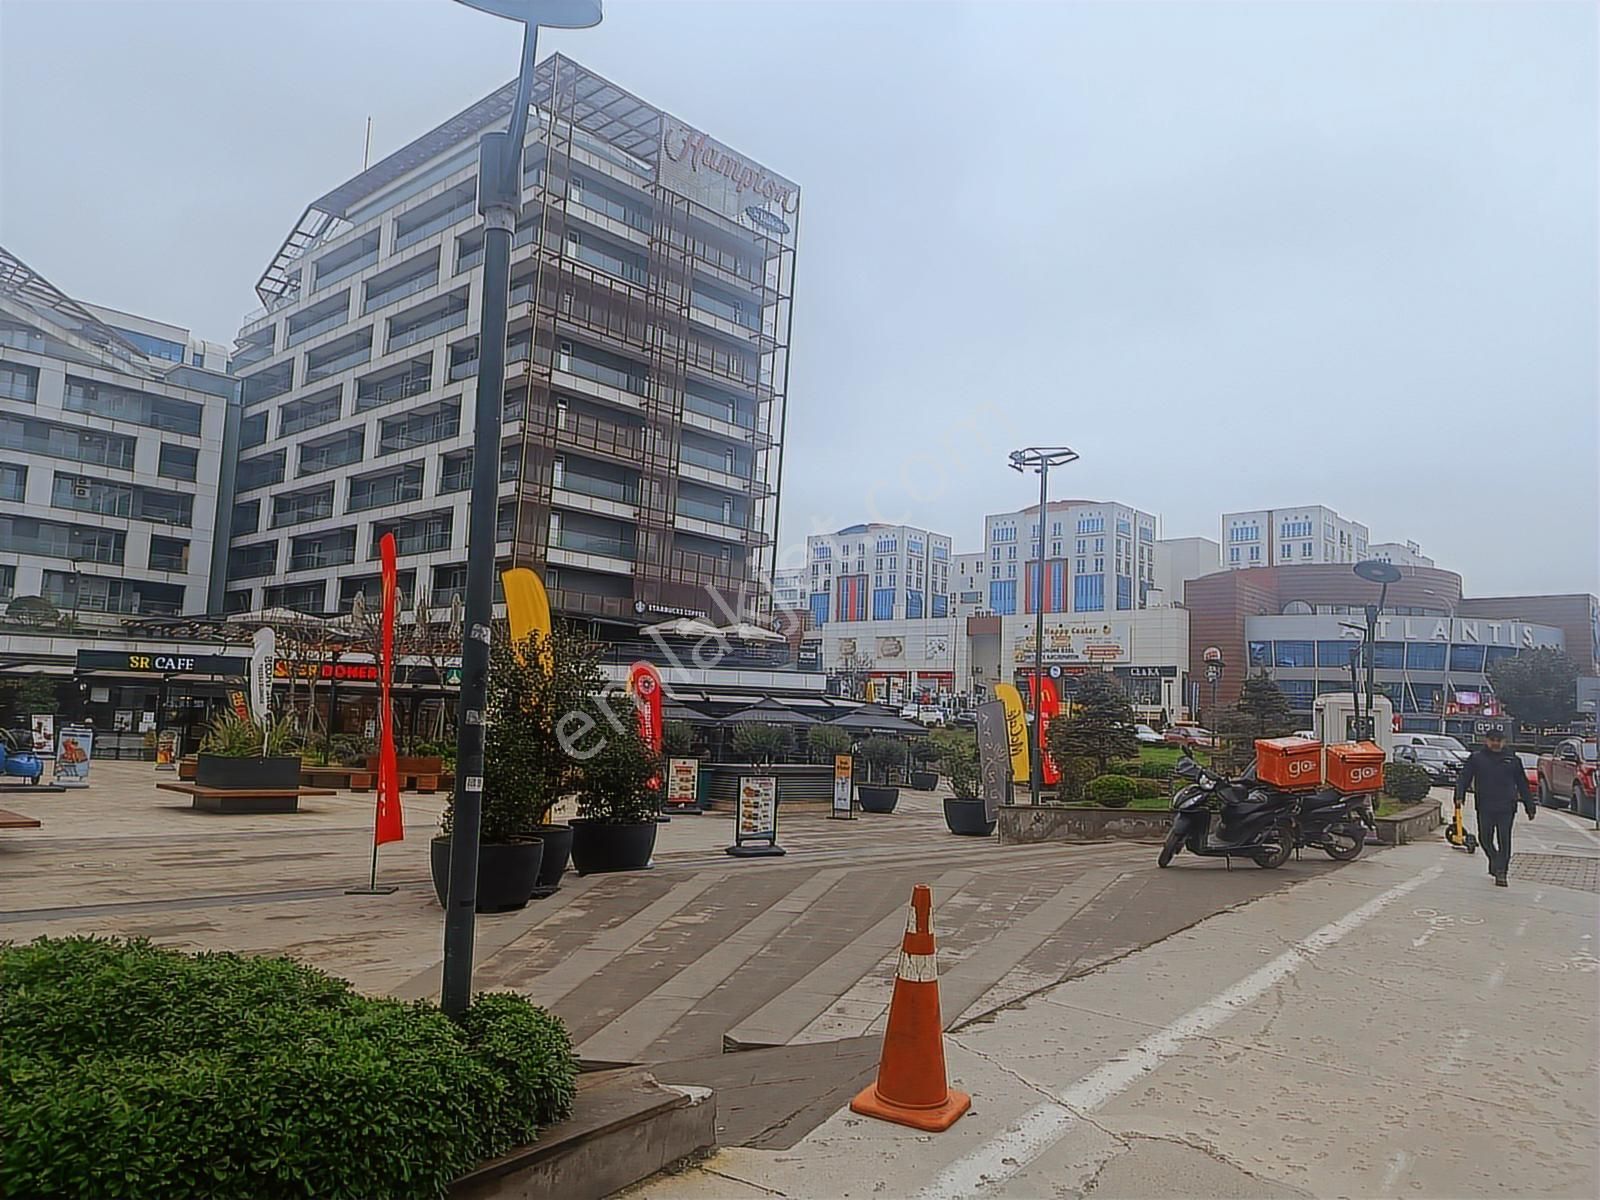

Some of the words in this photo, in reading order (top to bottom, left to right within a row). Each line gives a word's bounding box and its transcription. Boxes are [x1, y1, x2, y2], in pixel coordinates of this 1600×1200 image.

[664, 125, 799, 214] Hampton
[1338, 617, 1534, 648] ATLANTIS
[129, 656, 150, 669] SR
[154, 657, 195, 670] CAFE
[1288, 760, 1313, 778] go
[1350, 767, 1375, 783] go
